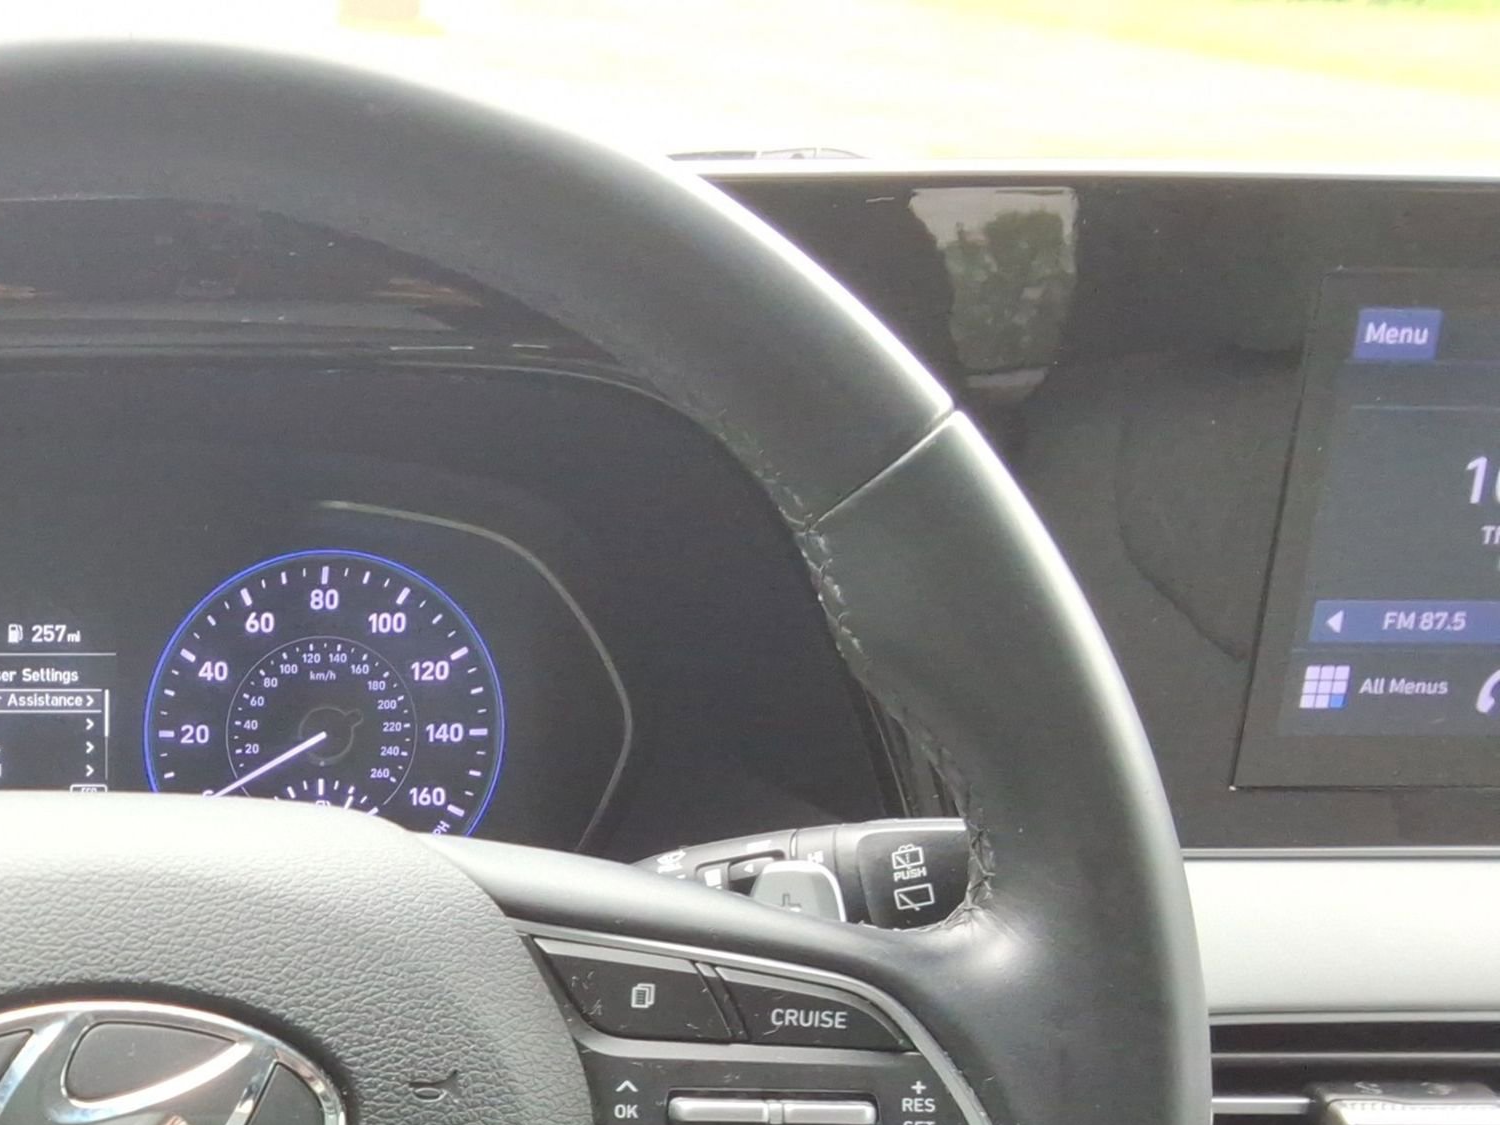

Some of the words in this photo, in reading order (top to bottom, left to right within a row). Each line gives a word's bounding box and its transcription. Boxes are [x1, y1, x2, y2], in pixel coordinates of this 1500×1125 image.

[1364, 321, 1429, 345] Menu
[1466, 456, 1500, 504] 1
[310, 589, 339, 609] 80
[245, 613, 275, 633] 60
[368, 613, 406, 633] 100
[1383, 612, 1415, 630] FM
[1419, 612, 1467, 631] 87.5
[302, 653, 321, 663] 120
[329, 653, 347, 663] 140
[22, 668, 79, 685] Settings
[198, 661, 228, 680] 40
[280, 664, 298, 674] 100
[309, 671, 336, 681] km/h
[351, 664, 369, 674] 160
[411, 661, 449, 681] 120
[263, 677, 278, 688] 80
[367, 680, 386, 690] 180
[1359, 678, 1384, 695] All
[1388, 678, 1449, 695] Menus
[7, 693, 83, 707] Assistance
[250, 696, 265, 706] 60
[377, 700, 397, 710] 200
[243, 720, 258, 730] 40
[383, 722, 402, 732] 220
[180, 725, 210, 744] 20
[425, 723, 464, 743] 140
[245, 744, 259, 754] 20
[380, 746, 400, 756] 240
[370, 768, 390, 778] 260
[409, 787, 446, 806] 160
[894, 867, 927, 882] PUSH
[770, 1008, 848, 1029] CRUISE
[614, 1104, 639, 1119] OK
[902, 1098, 936, 1113] RES
